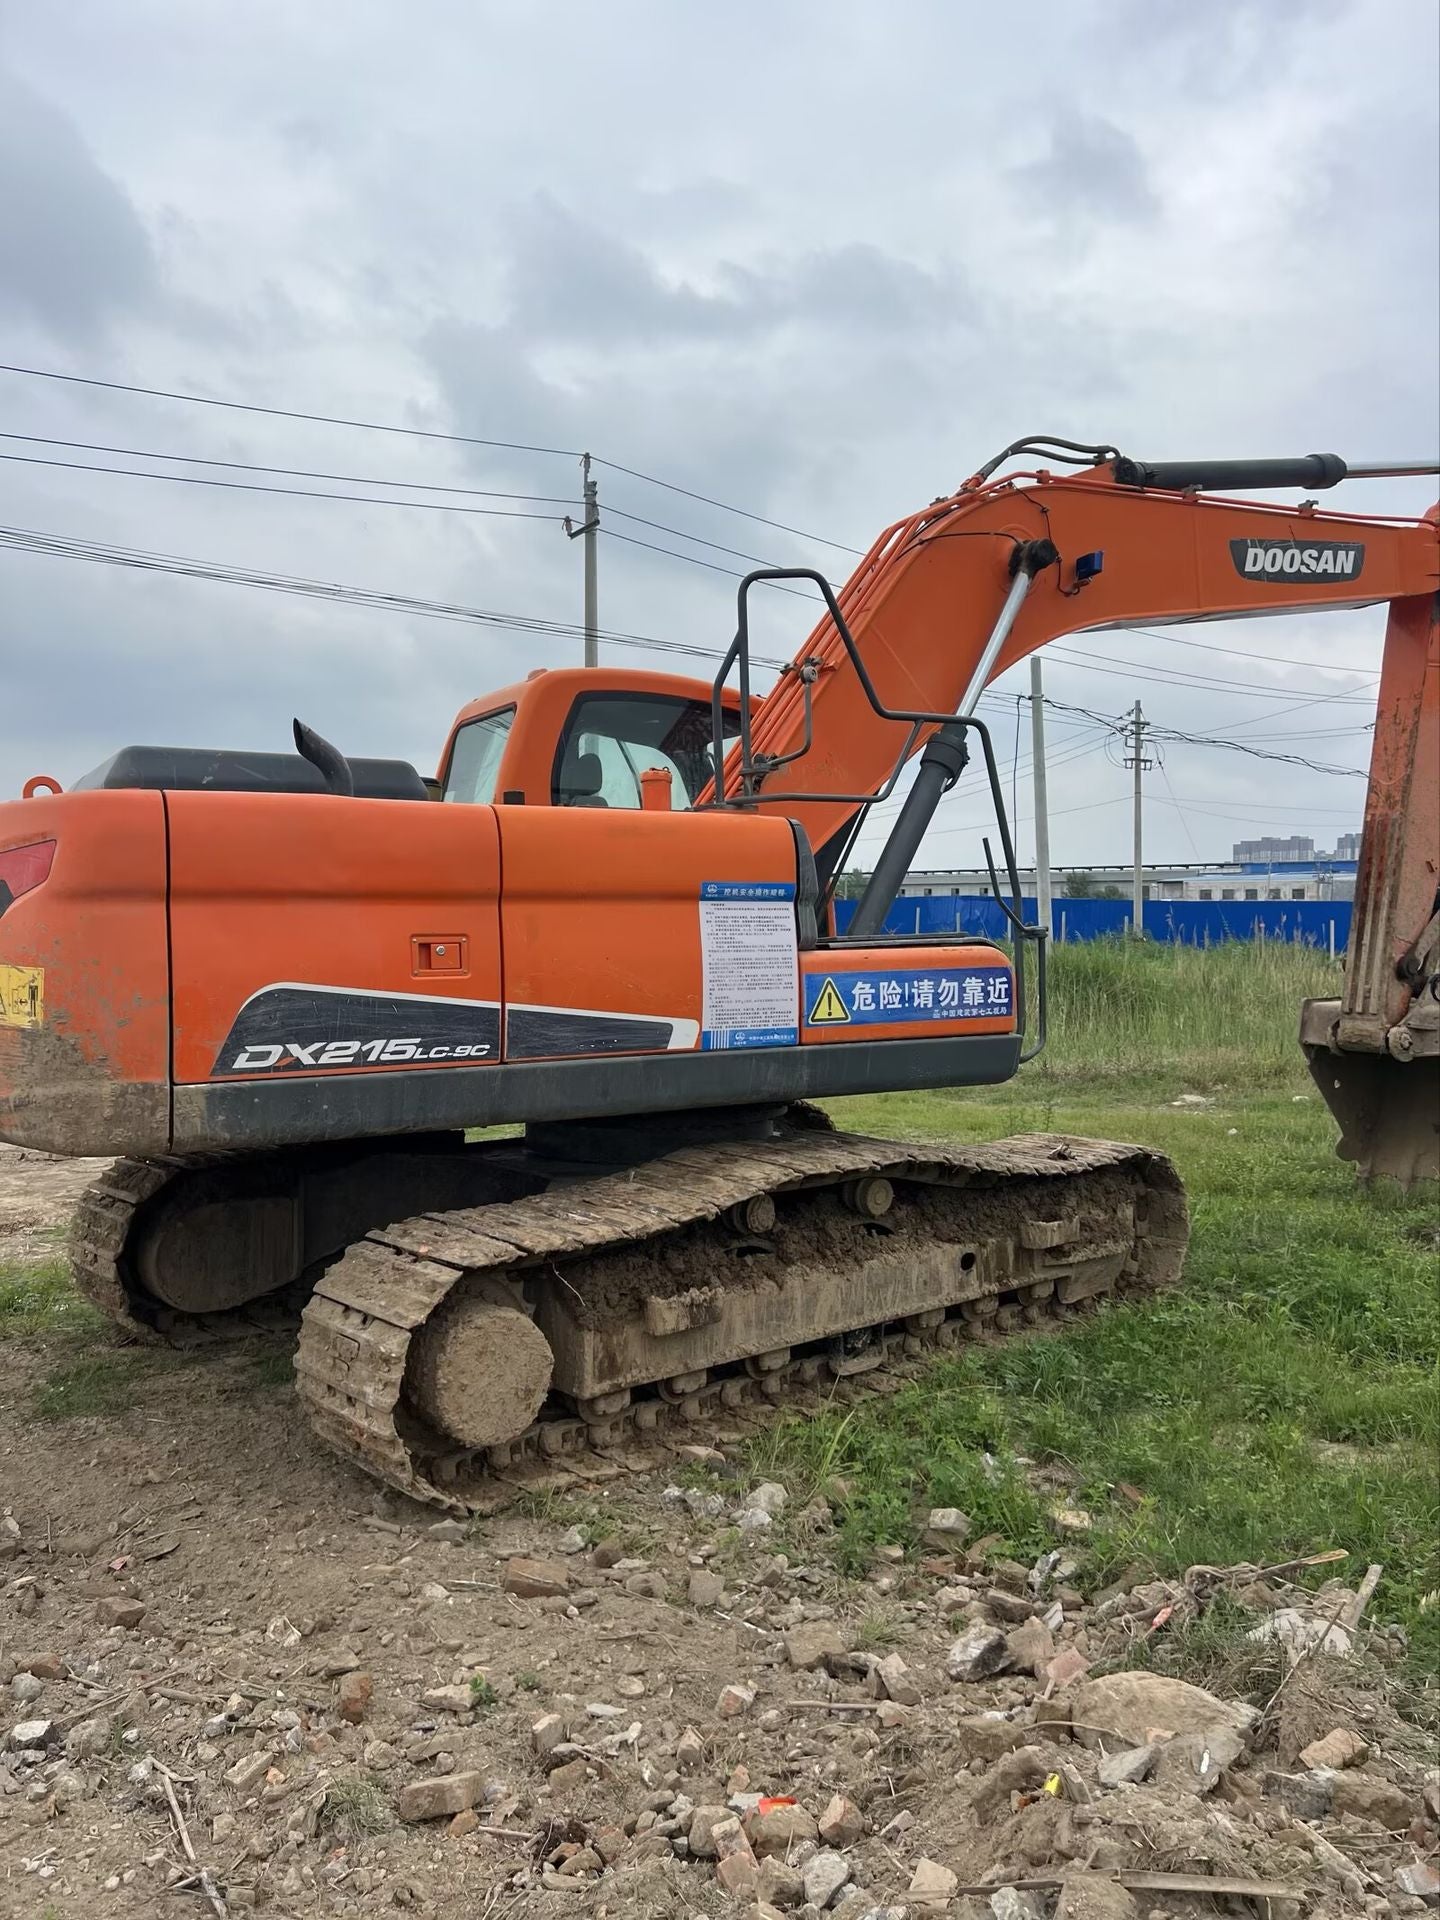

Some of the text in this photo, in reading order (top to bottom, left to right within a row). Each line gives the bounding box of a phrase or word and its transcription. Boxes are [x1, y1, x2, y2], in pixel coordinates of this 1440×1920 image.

[1244, 547, 1356, 574] DOOSAN
[851, 976, 1009, 1011] 危险!请勿靠近
[231, 1037, 491, 1069] DX215LC-9C
